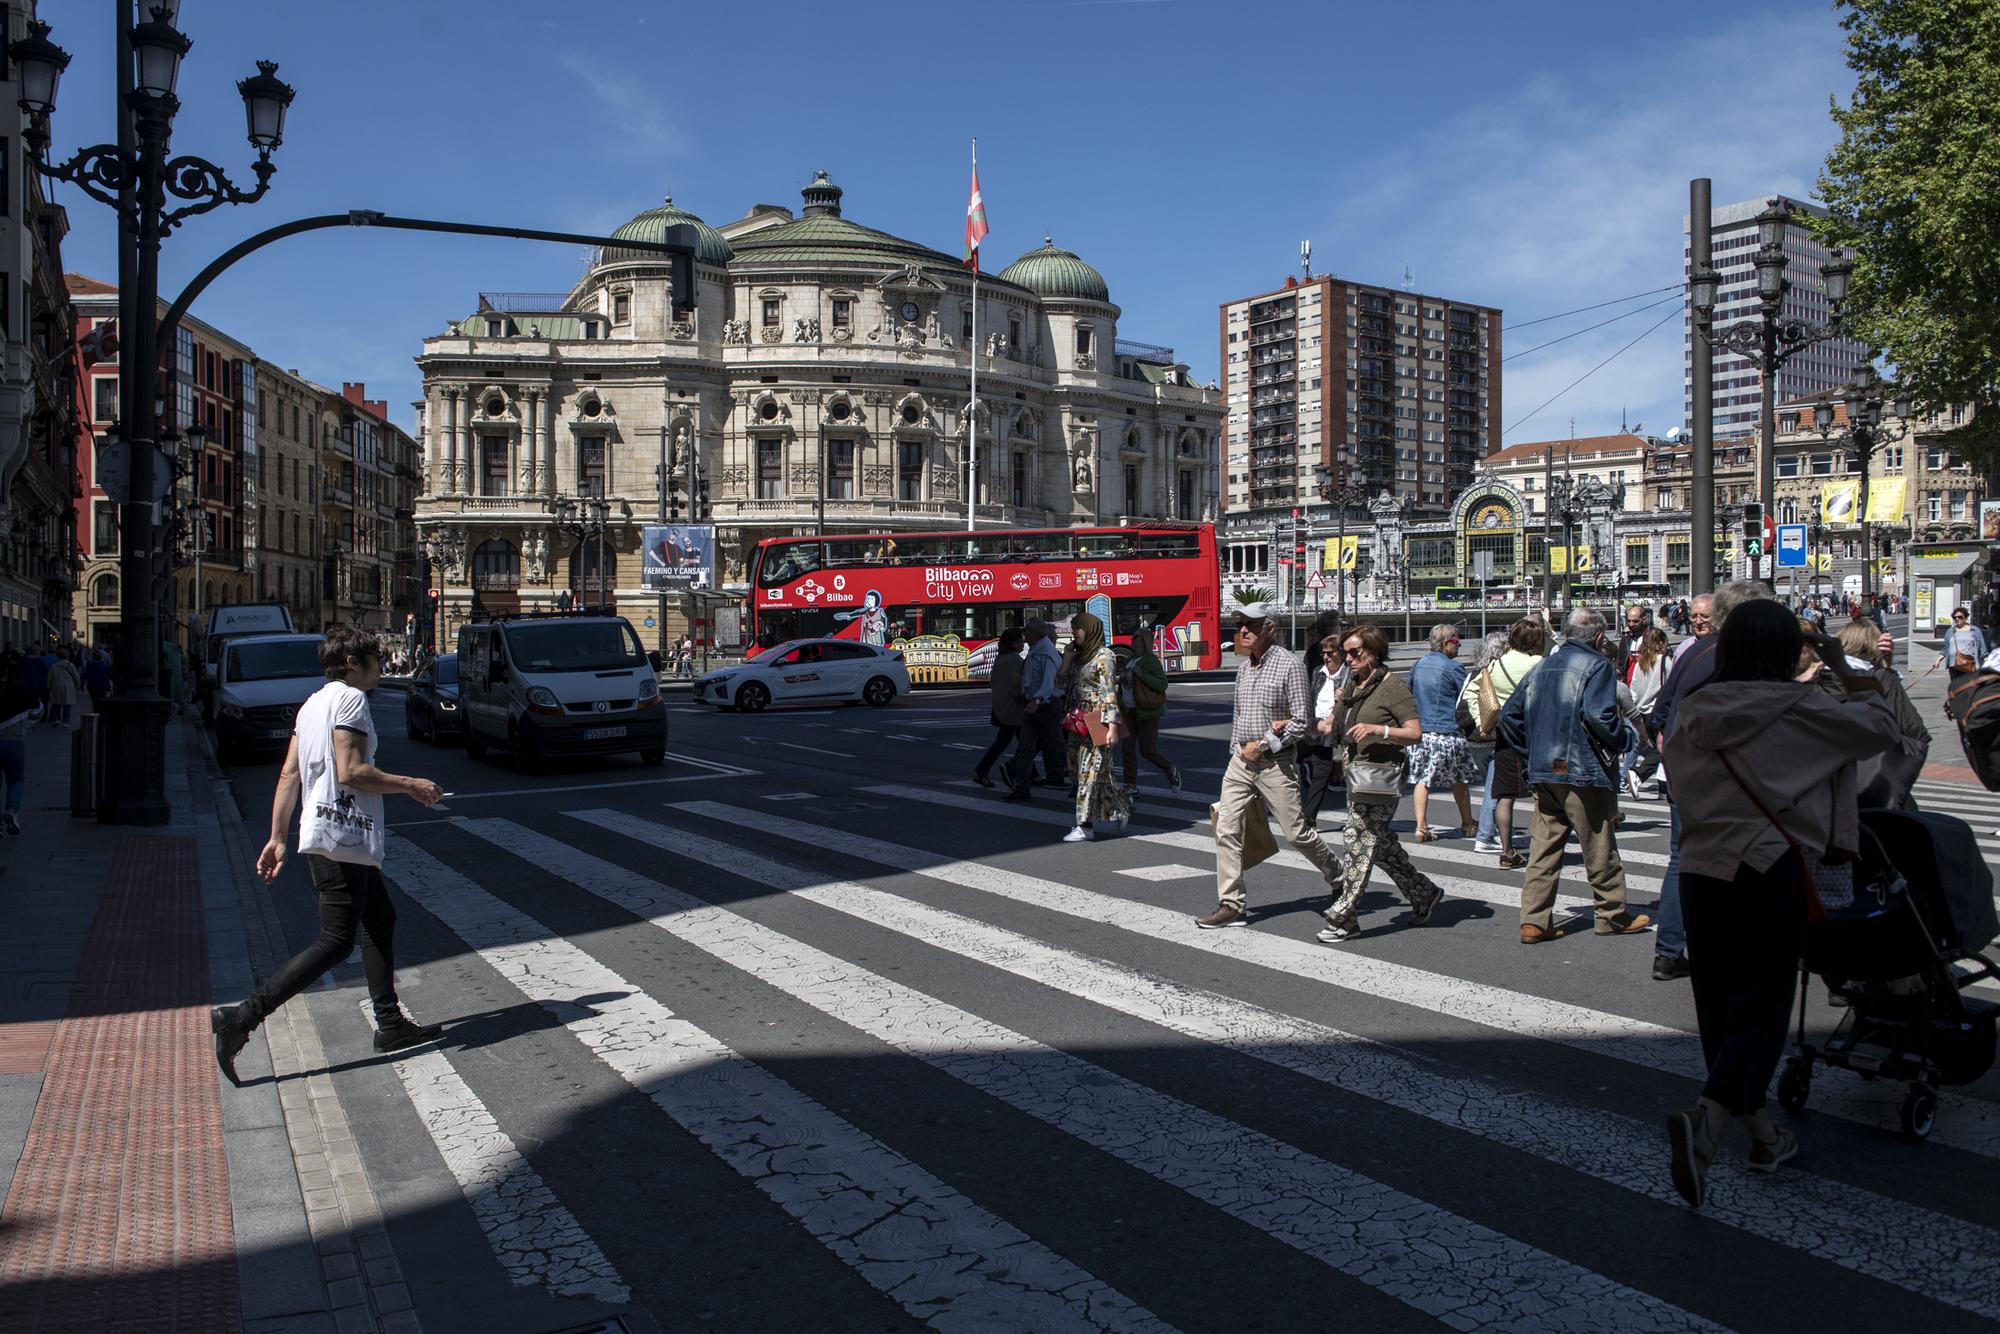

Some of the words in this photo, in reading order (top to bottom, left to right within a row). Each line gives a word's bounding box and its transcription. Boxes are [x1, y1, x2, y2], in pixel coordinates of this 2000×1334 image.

[925, 568, 968, 582] Bilbao
[827, 593, 853, 602] Bilbao
[926, 582, 954, 600] City
[958, 582, 994, 597] View
[316, 805, 373, 831] WAYNE
